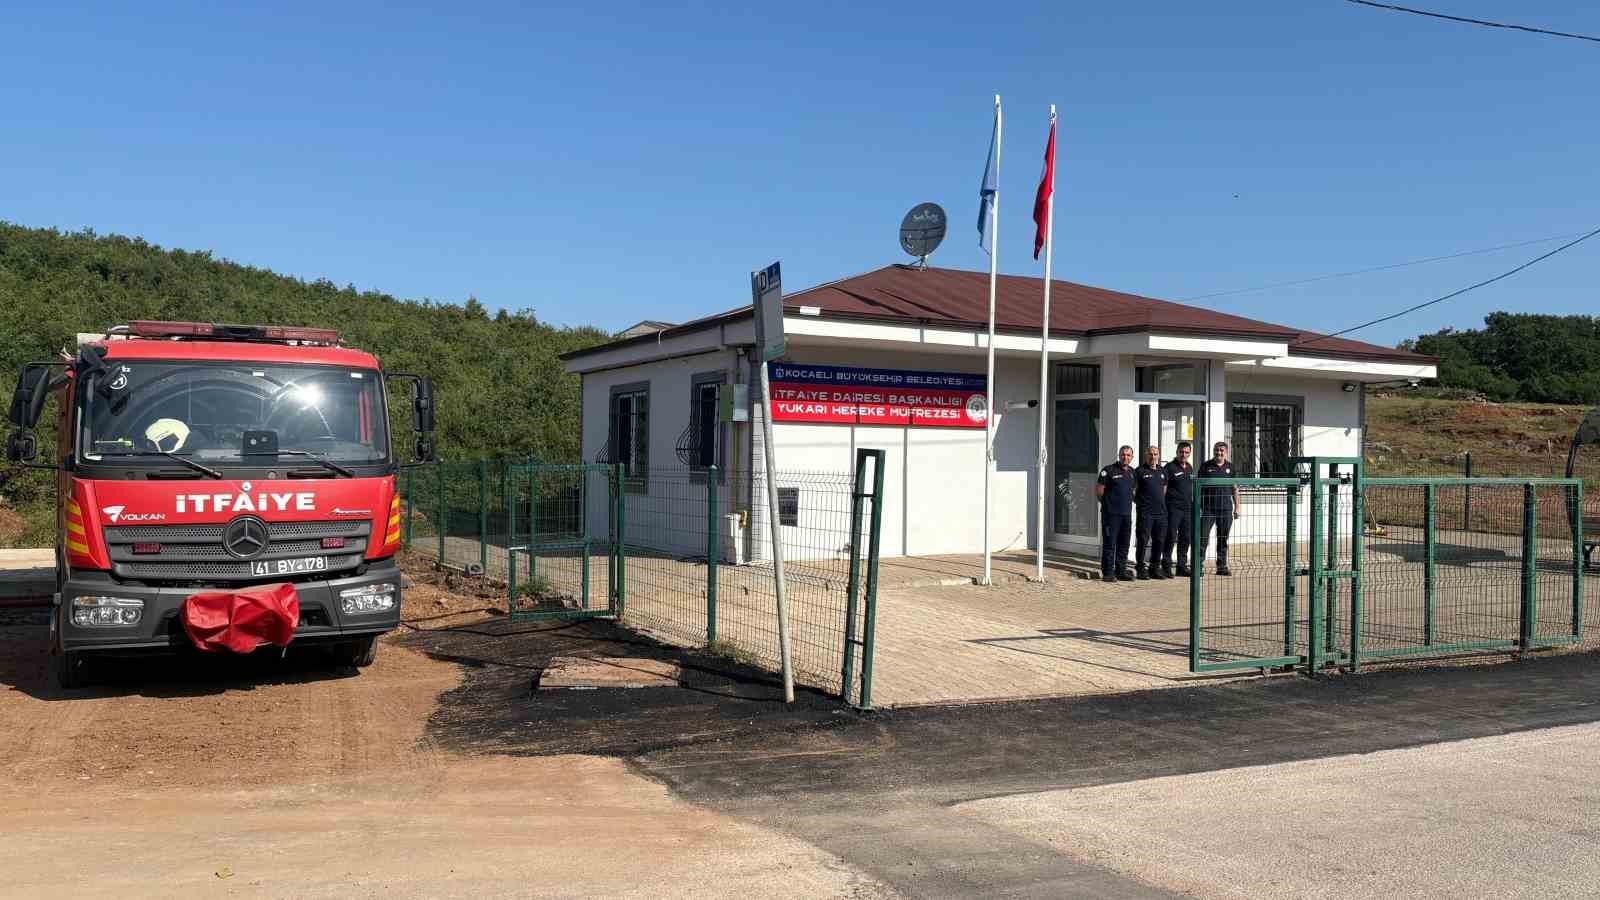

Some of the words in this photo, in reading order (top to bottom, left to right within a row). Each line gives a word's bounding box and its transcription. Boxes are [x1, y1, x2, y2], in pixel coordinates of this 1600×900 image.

[777, 403, 827, 414] YUKARI
[832, 405, 885, 416] HEREKE
[120, 513, 166, 521] VOLKAN
[256, 562, 268, 575] 41
[277, 560, 296, 573] BY
[304, 557, 324, 569] 178
